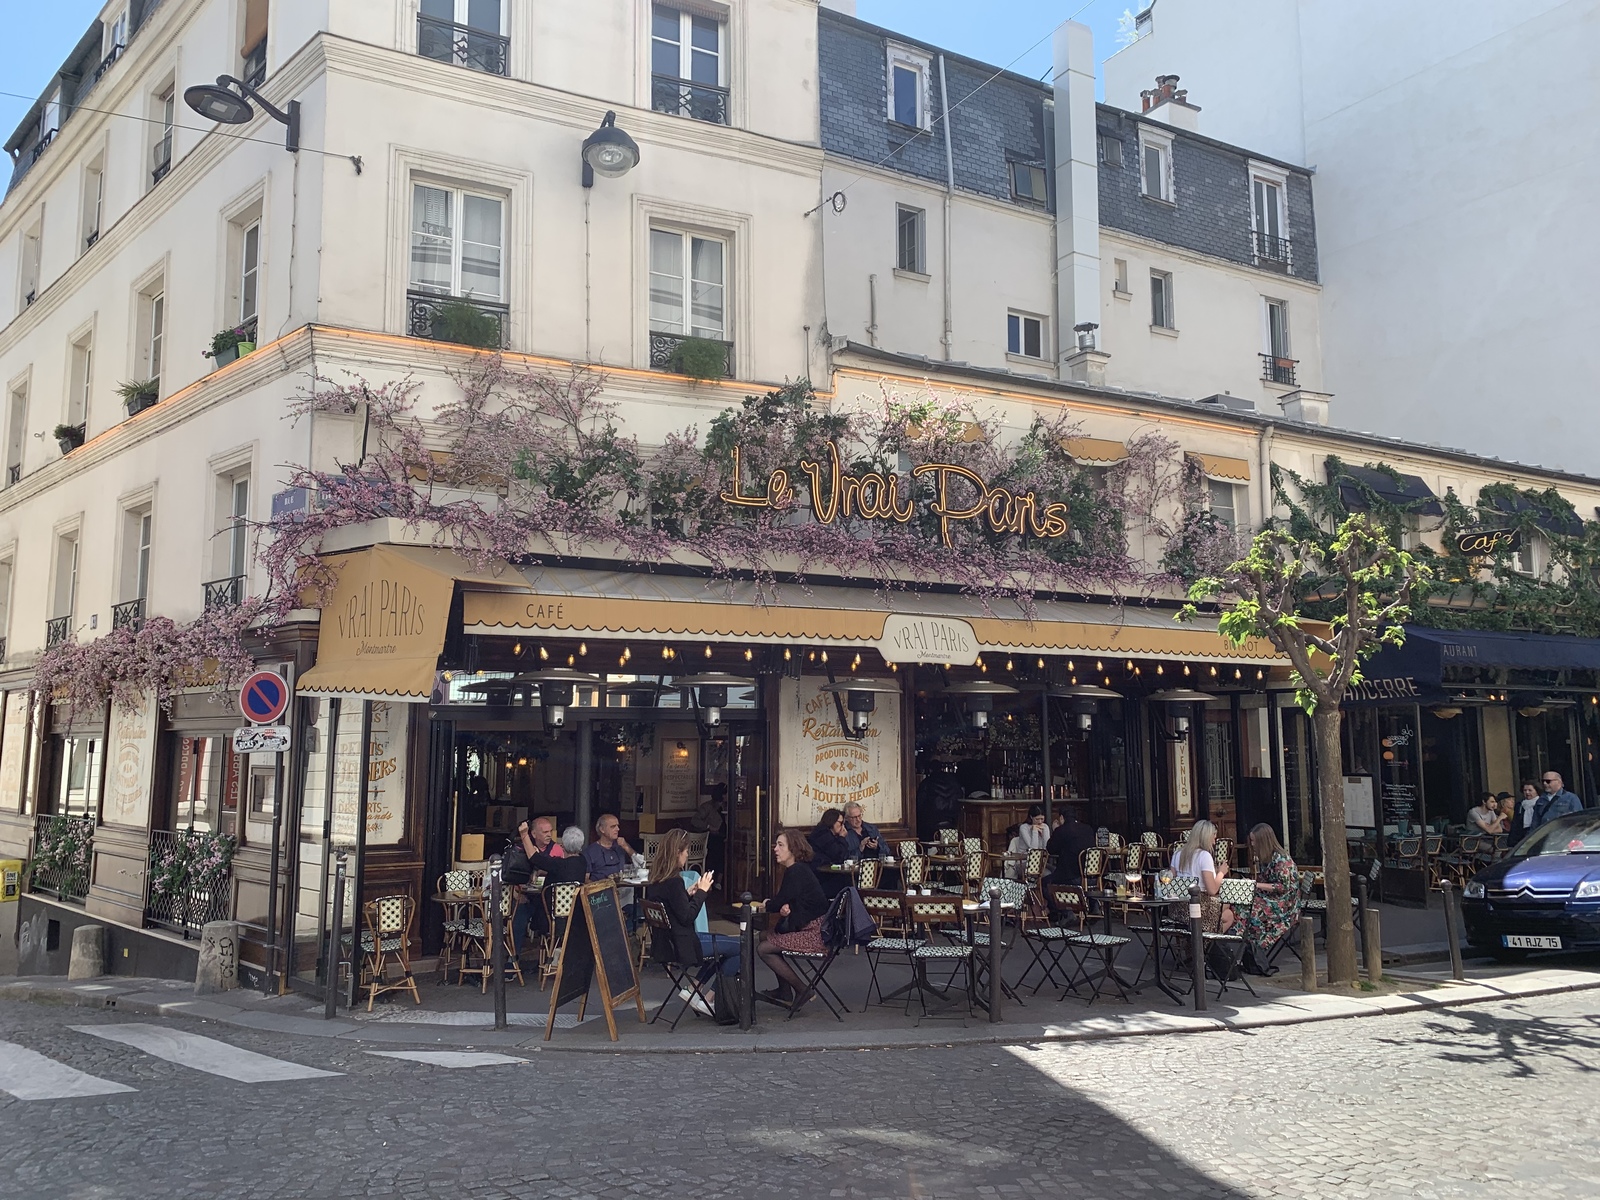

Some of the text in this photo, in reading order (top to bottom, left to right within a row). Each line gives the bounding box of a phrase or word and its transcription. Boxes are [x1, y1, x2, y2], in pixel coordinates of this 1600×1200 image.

[720, 441, 1068, 549] Le Vrai Paris
[338, 579, 425, 639] VRAI PARIS
[526, 603, 564, 619] CAFÉ
[893, 621, 969, 652] VRAI PARIS
[356, 640, 398, 656] Montmartre
[917, 650, 951, 660] Montmartre
[1343, 677, 1421, 701] ANCERRE
[815, 748, 870, 764] PRODUITS FRAIS
[839, 761, 846, 771] &
[815, 770, 869, 788] FAIT MAISON
[812, 788, 847, 803] TOUTE
[849, 782, 881, 802] HEURE
[1512, 937, 1558, 948] 41 RJZ 75
